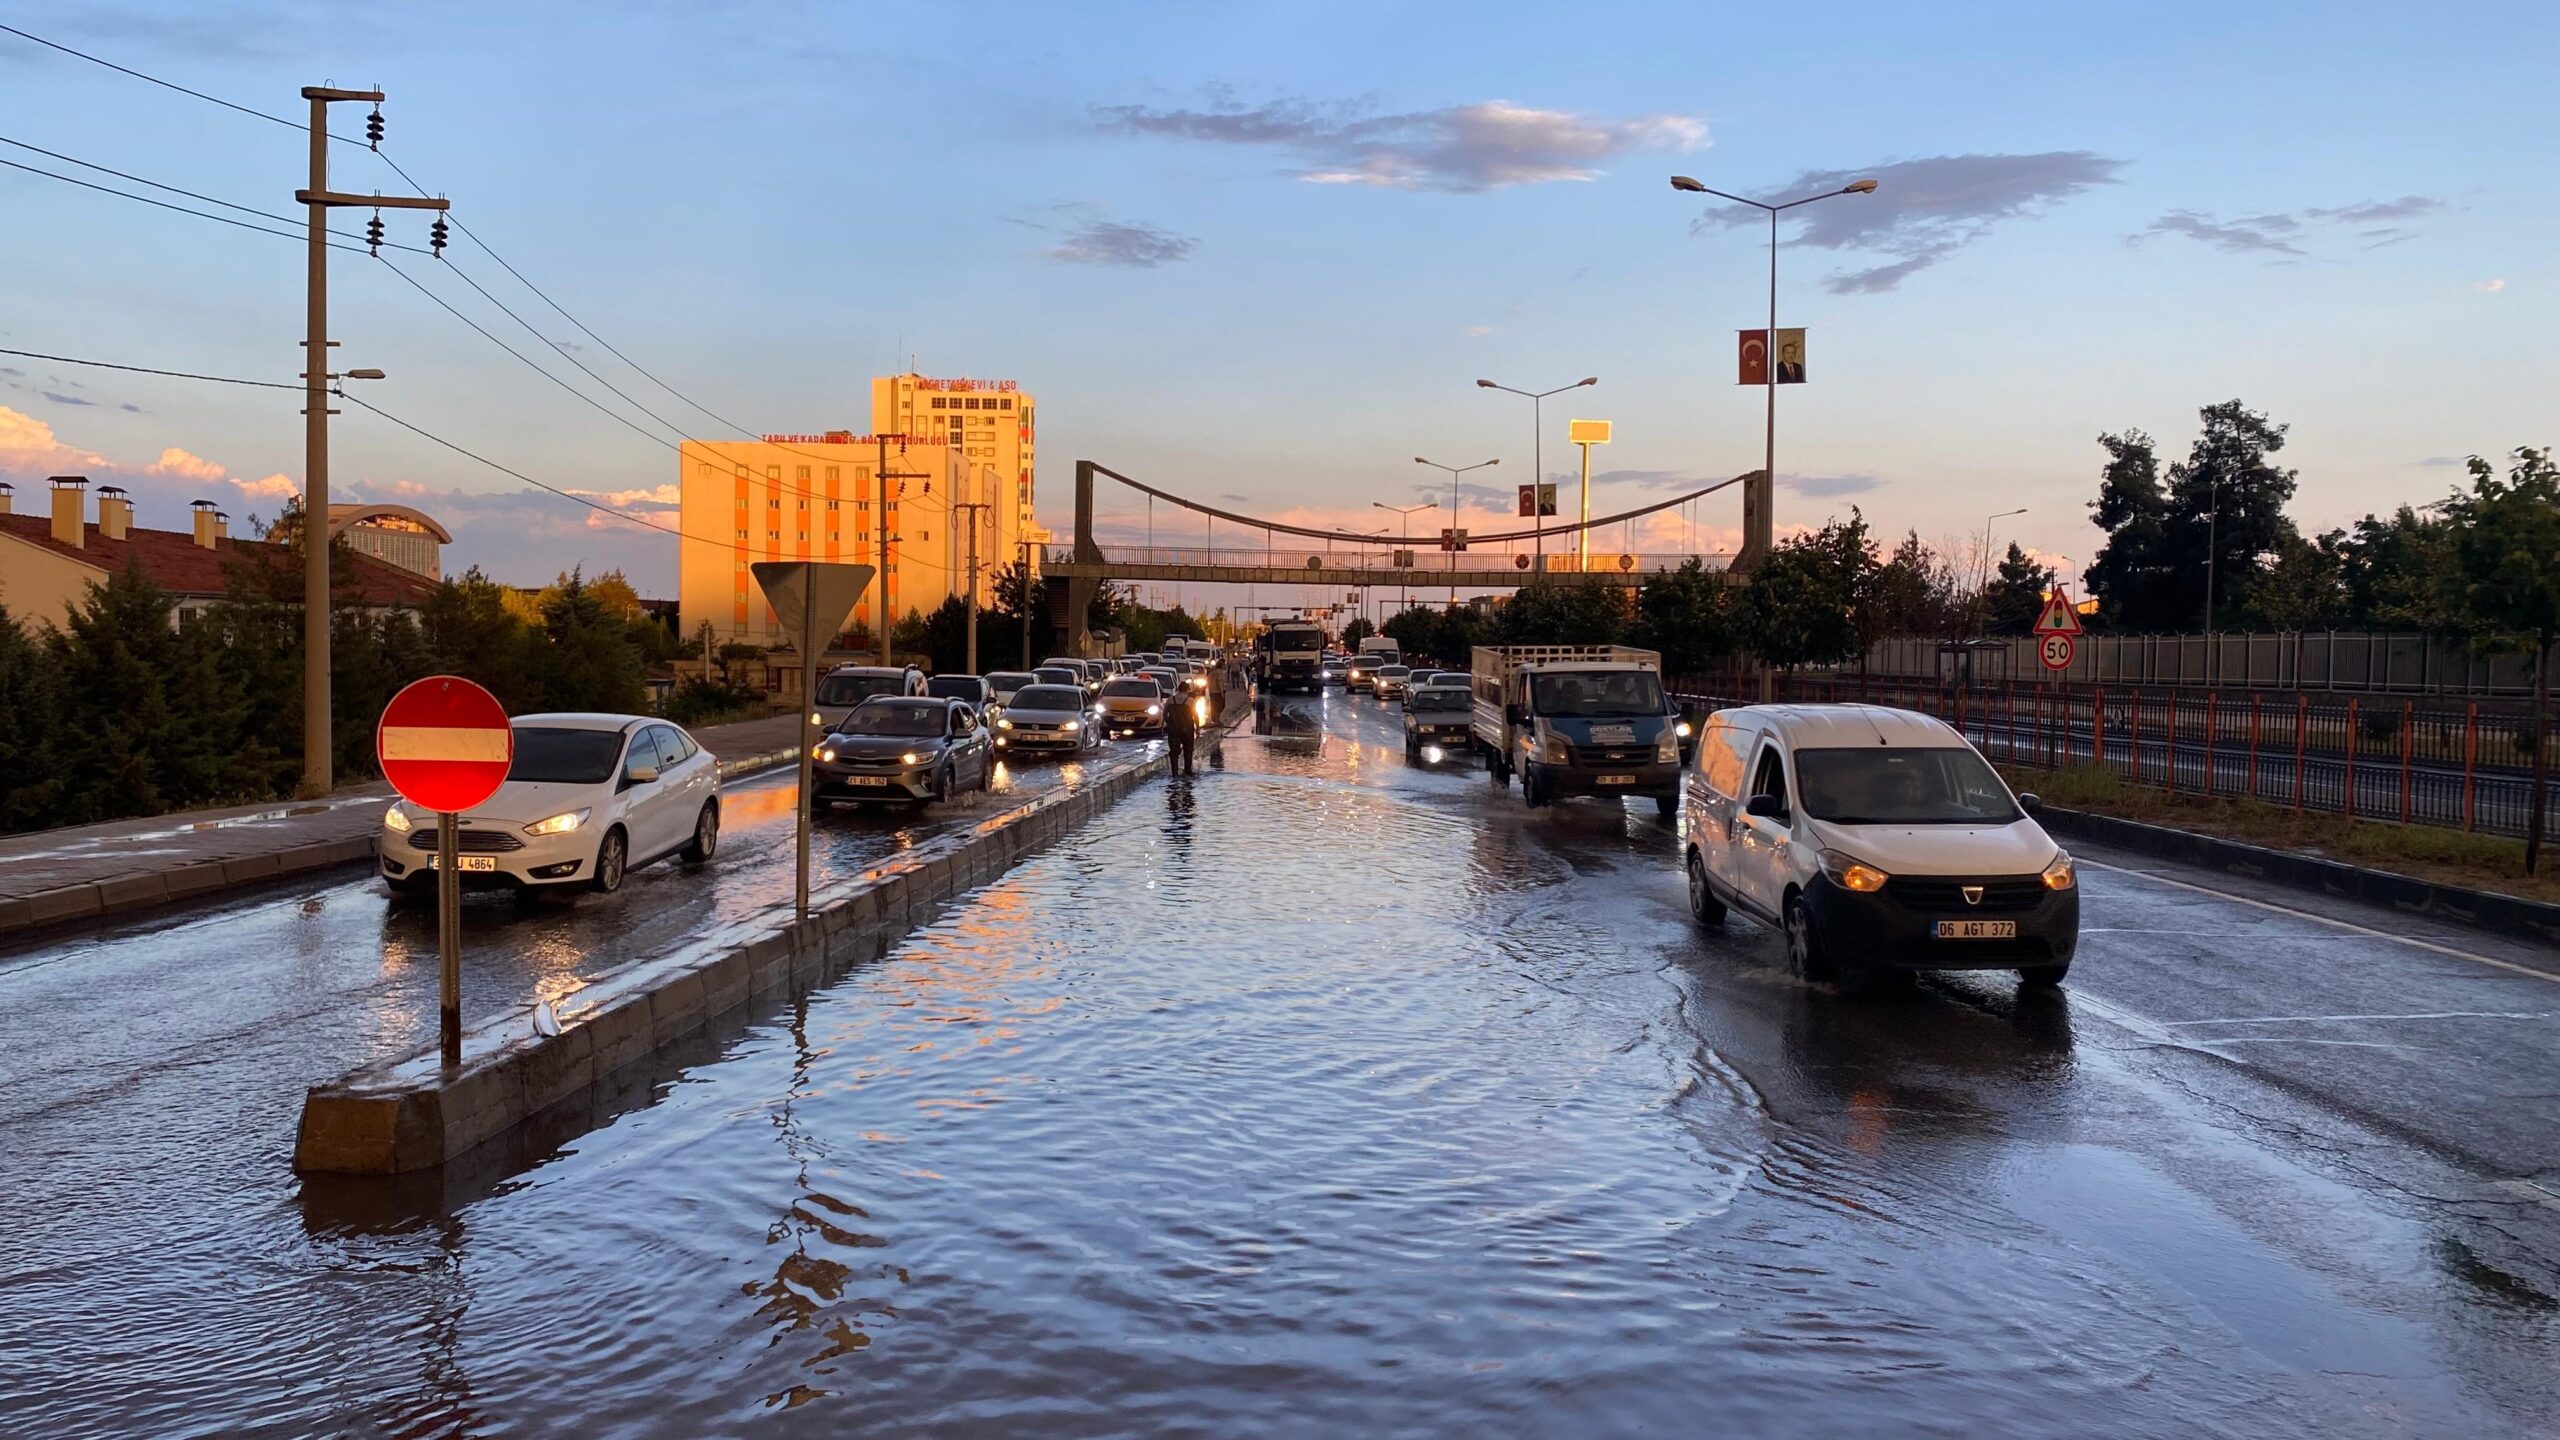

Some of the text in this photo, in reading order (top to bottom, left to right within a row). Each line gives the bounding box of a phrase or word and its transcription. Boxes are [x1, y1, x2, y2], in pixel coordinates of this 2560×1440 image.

[861, 434, 890, 445] BÖLE
[2046, 641, 2069, 660] 50
[468, 857, 492, 870] 4864
[1939, 922, 2014, 937] 06 AGT 372
